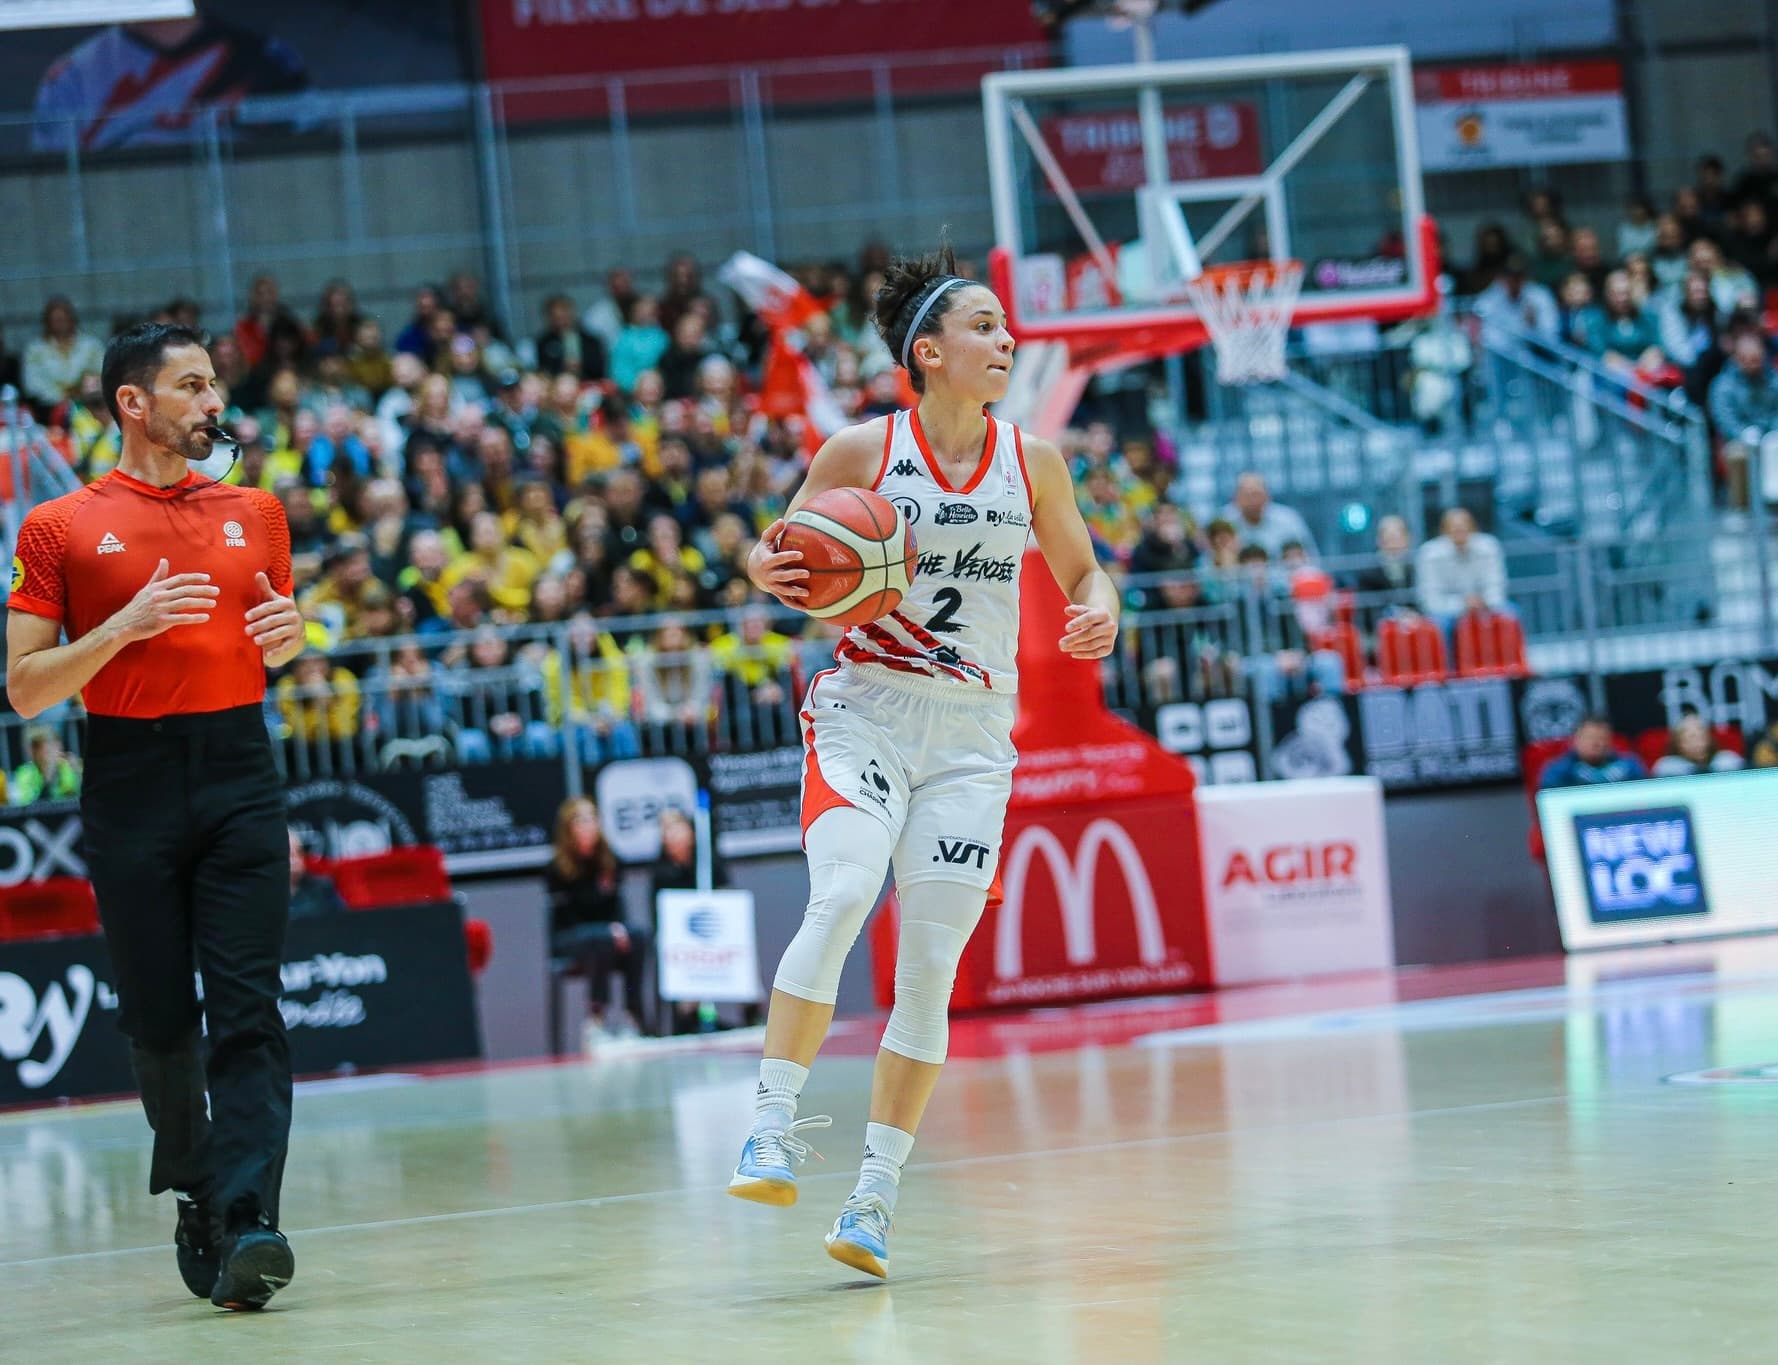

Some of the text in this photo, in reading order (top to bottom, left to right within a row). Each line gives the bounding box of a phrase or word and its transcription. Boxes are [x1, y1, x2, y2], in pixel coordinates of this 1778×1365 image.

[97, 543, 126, 555] PEAK
[226, 538, 246, 547] FFBB
[924, 587, 970, 632] 2
[1583, 820, 1688, 861] NEW
[1222, 841, 1357, 889] AGIR
[1590, 854, 1697, 911] LOC
